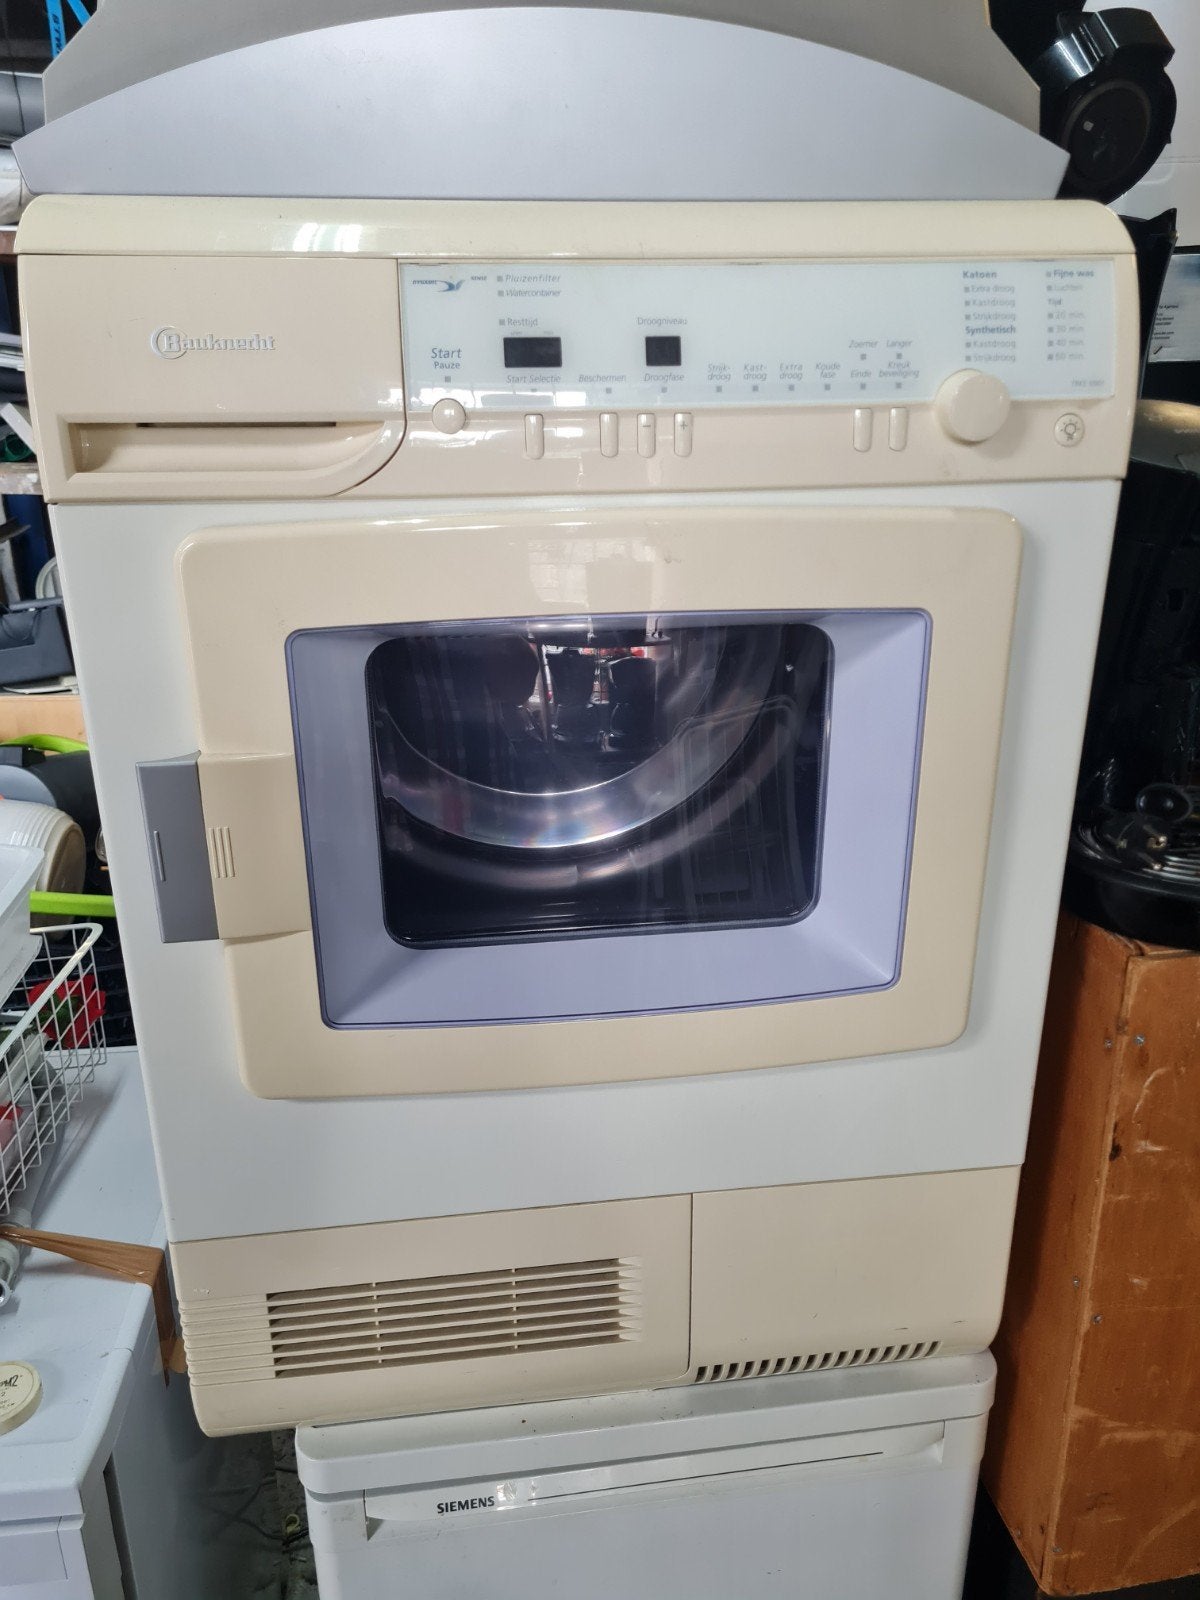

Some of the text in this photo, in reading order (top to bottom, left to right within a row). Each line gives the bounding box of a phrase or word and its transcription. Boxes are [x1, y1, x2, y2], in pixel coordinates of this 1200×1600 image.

[505, 274, 561, 283] Pluizenfilter
[962, 270, 998, 279] Katoen
[1053, 269, 1095, 279] Fijne was
[505, 289, 562, 297] Watercontainer
[971, 285, 1015, 294] Extra droog
[972, 299, 1016, 308] Kastdroog
[637, 317, 688, 326] Droogniveau
[972, 313, 1016, 322] Strijkdroog
[507, 318, 538, 327] Resttijd
[965, 325, 1016, 336] Synthetisch
[160, 330, 277, 354] Bauknecht
[849, 340, 878, 348] Zoemer
[886, 340, 913, 349] Langer
[973, 340, 1016, 349] Kastdroog
[431, 347, 462, 359] Start
[434, 361, 461, 370] Pauze
[779, 363, 803, 371] Extra
[815, 362, 841, 371] Koude
[888, 361, 911, 369] Kreuk
[644, 372, 685, 382] Droogfase
[707, 371, 731, 381] droog
[743, 371, 767, 381] droog
[779, 371, 803, 381] droog
[820, 370, 837, 380] fase
[850, 369, 872, 378] Einde
[878, 368, 920, 378] beveiliging
[506, 374, 561, 383] Start Selectie
[578, 374, 627, 383] Beschermen
[436, 1496, 495, 1514] SIEMENS
